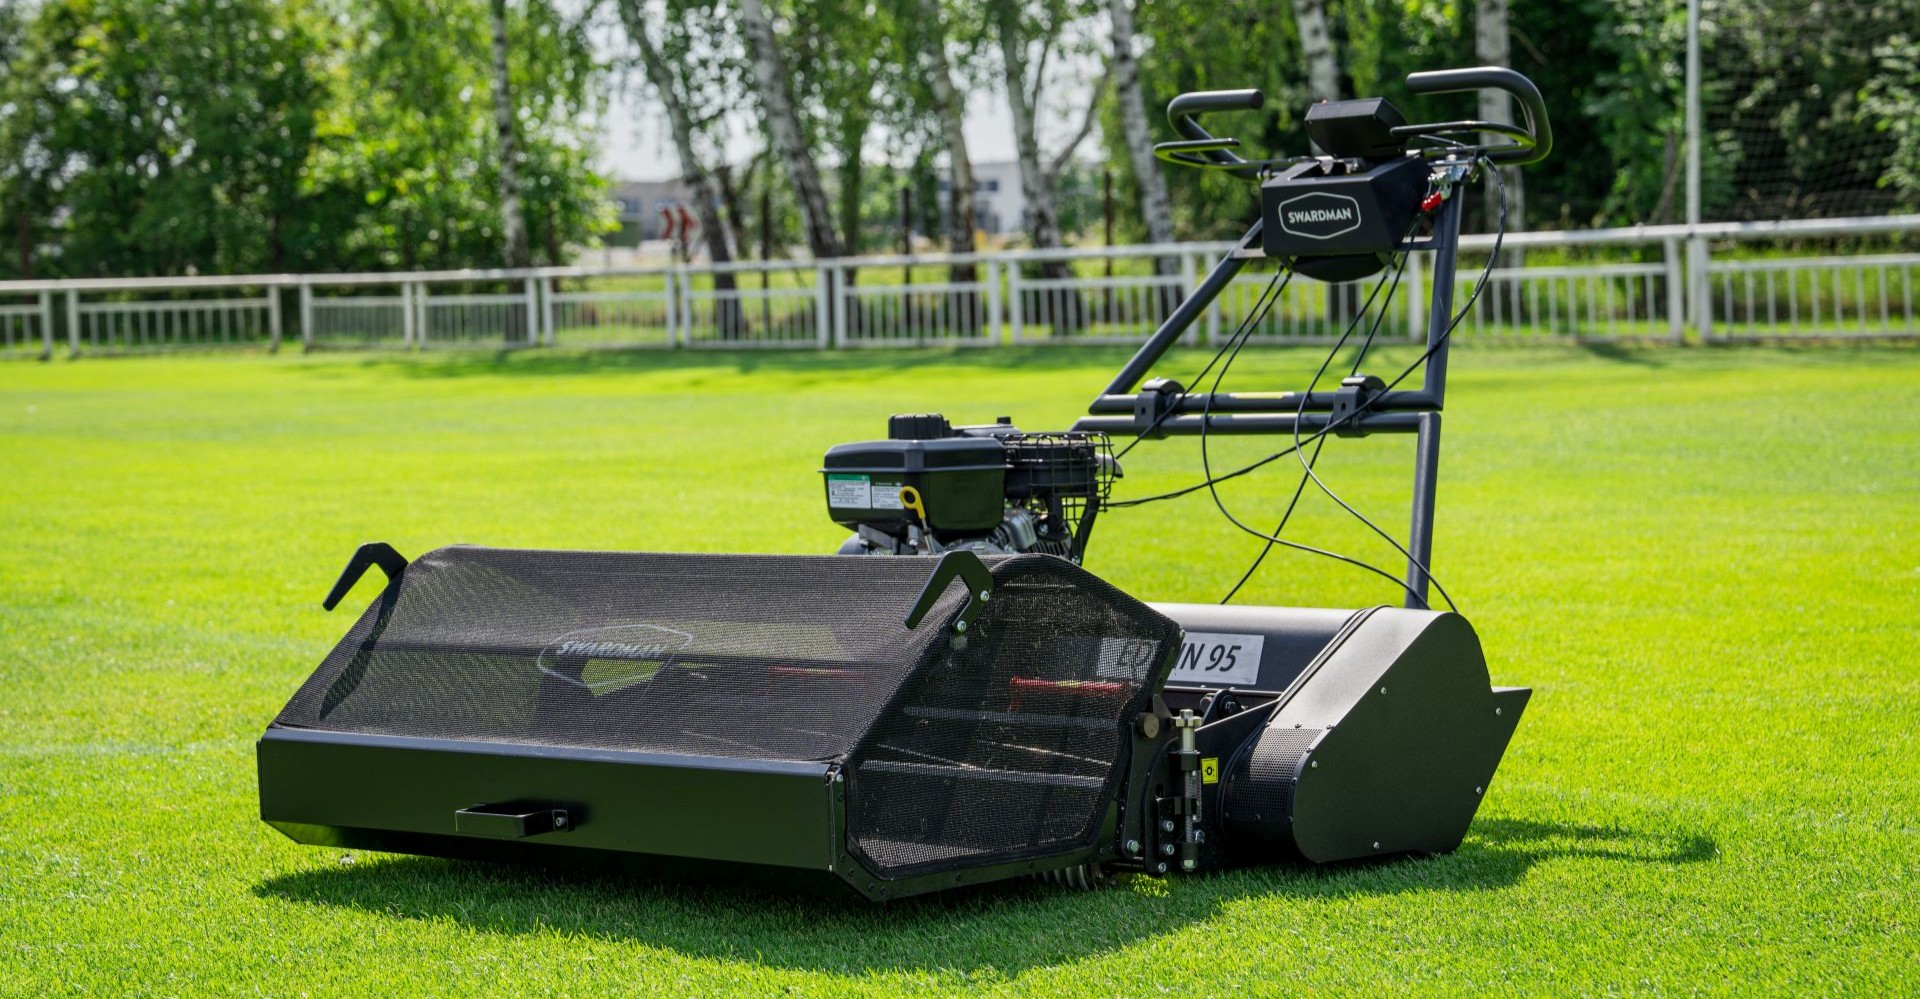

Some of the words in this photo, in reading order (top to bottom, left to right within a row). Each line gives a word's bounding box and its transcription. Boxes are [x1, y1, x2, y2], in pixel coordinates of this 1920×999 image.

[1287, 207, 1353, 224] SWARDMAN
[1117, 639, 1206, 670] EDIN
[1205, 644, 1242, 672] 95
